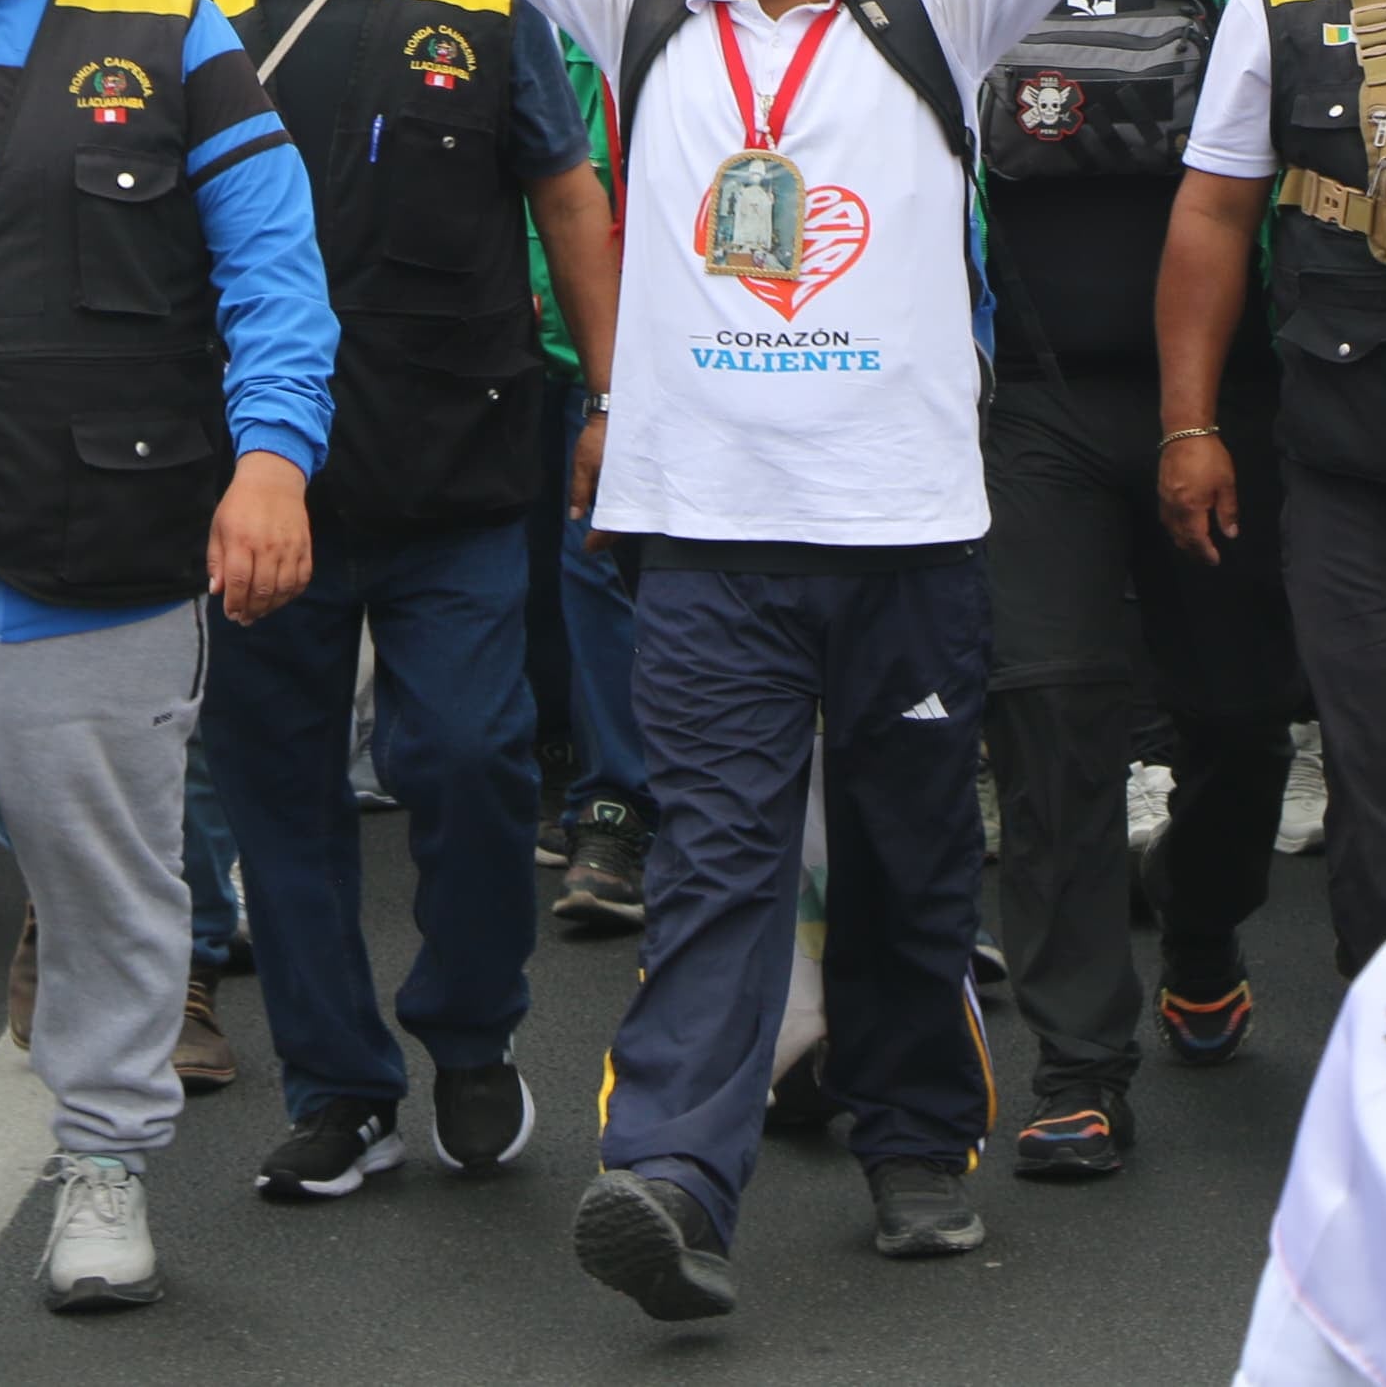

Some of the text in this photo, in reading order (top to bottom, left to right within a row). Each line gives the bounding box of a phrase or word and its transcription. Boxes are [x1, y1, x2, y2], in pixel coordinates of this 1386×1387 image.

[403, 24, 477, 72] RONDA CAMPESINA
[69, 57, 154, 96] RONDA CAMPESINA
[716, 327, 850, 348] CORAZÓN
[690, 347, 881, 372] VALIENTE
